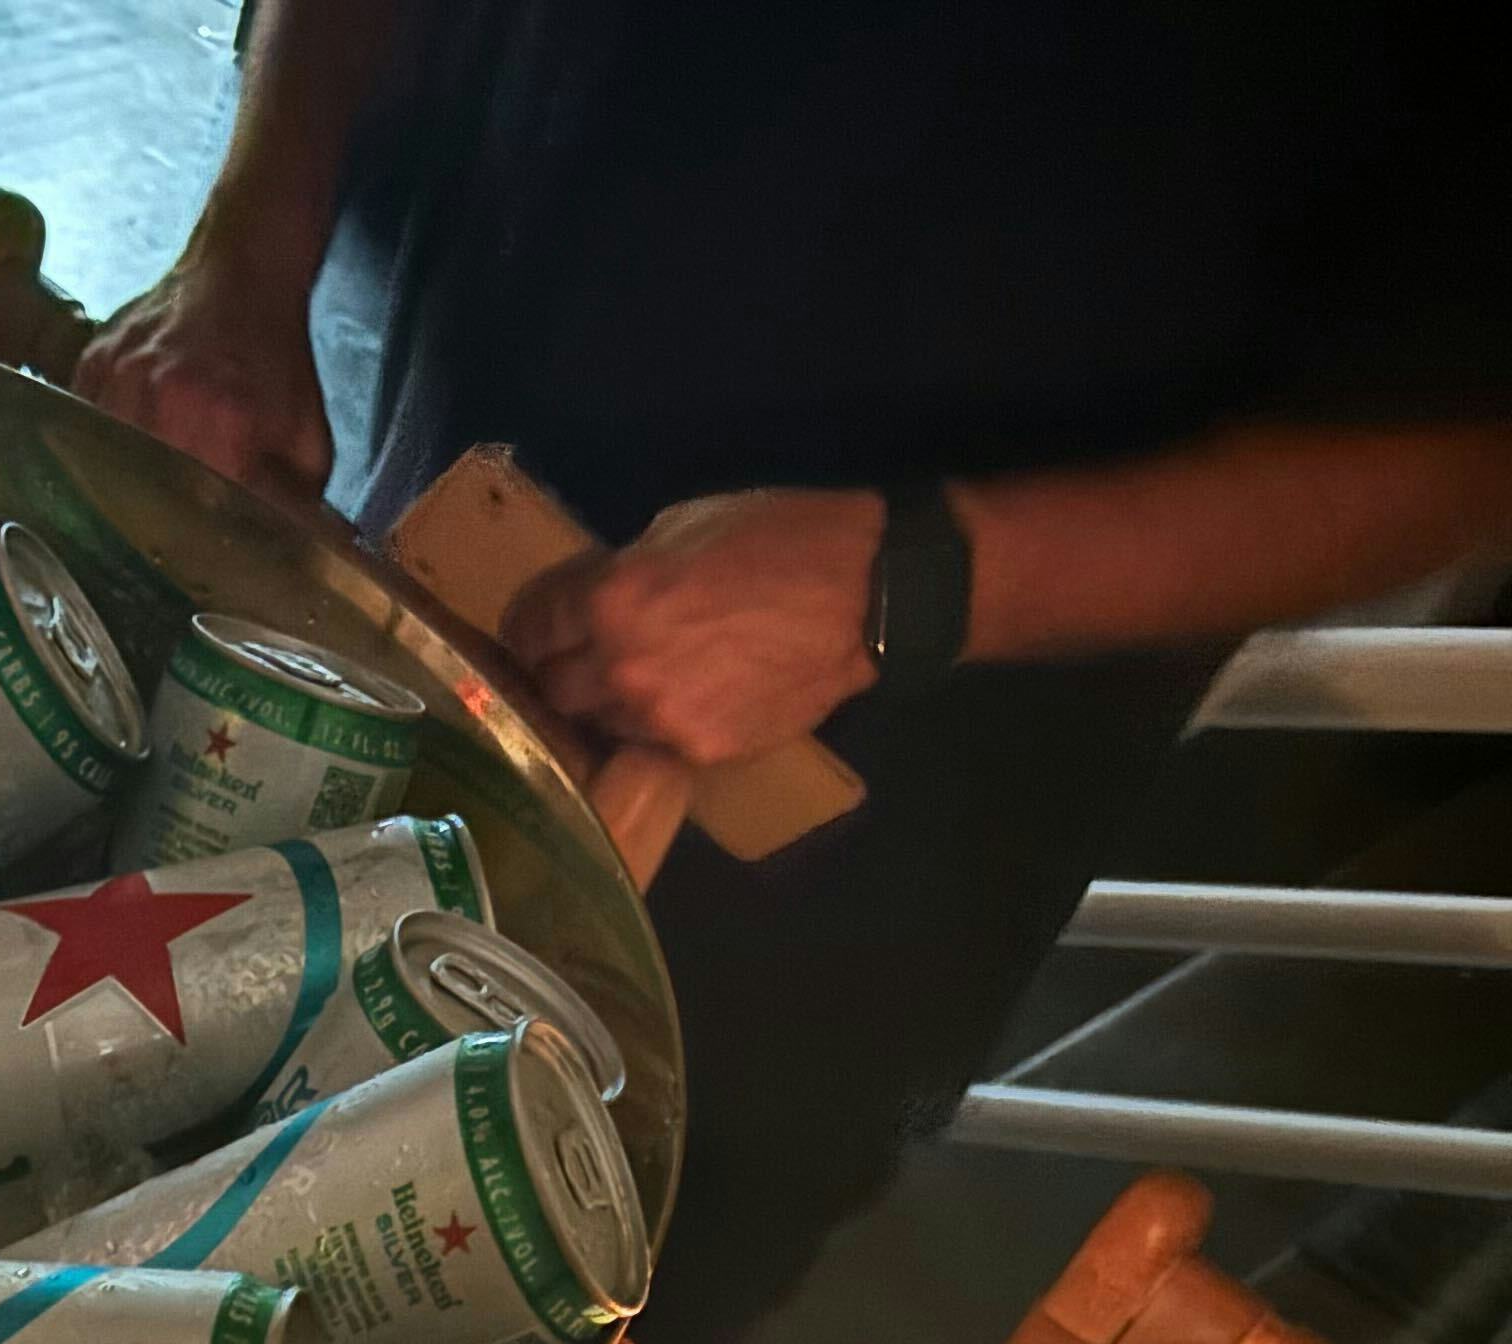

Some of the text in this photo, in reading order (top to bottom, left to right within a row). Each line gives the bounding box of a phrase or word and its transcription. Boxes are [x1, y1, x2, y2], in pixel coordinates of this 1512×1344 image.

[373, 1214, 424, 1307] SILVER
[388, 1178, 462, 1314] Heineken
[477, 1154, 538, 1284] ALC./VOL.
